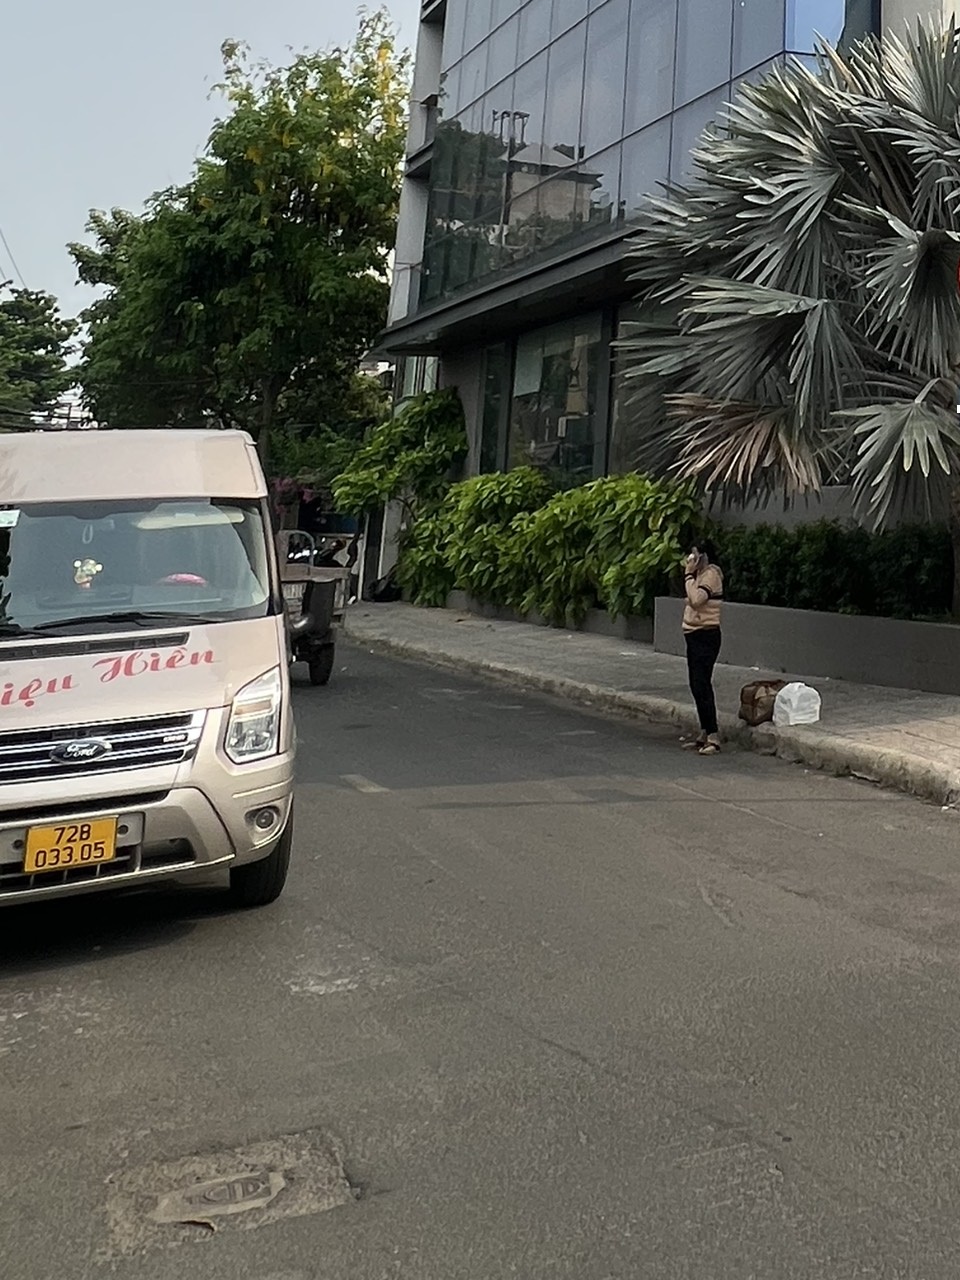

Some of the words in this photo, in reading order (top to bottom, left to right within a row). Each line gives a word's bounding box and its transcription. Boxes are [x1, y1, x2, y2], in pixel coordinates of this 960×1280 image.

[0, 673, 74, 707] iệu
[63, 743, 98, 758] Ford
[54, 823, 91, 845] 72B
[35, 841, 105, 868] 033.05
